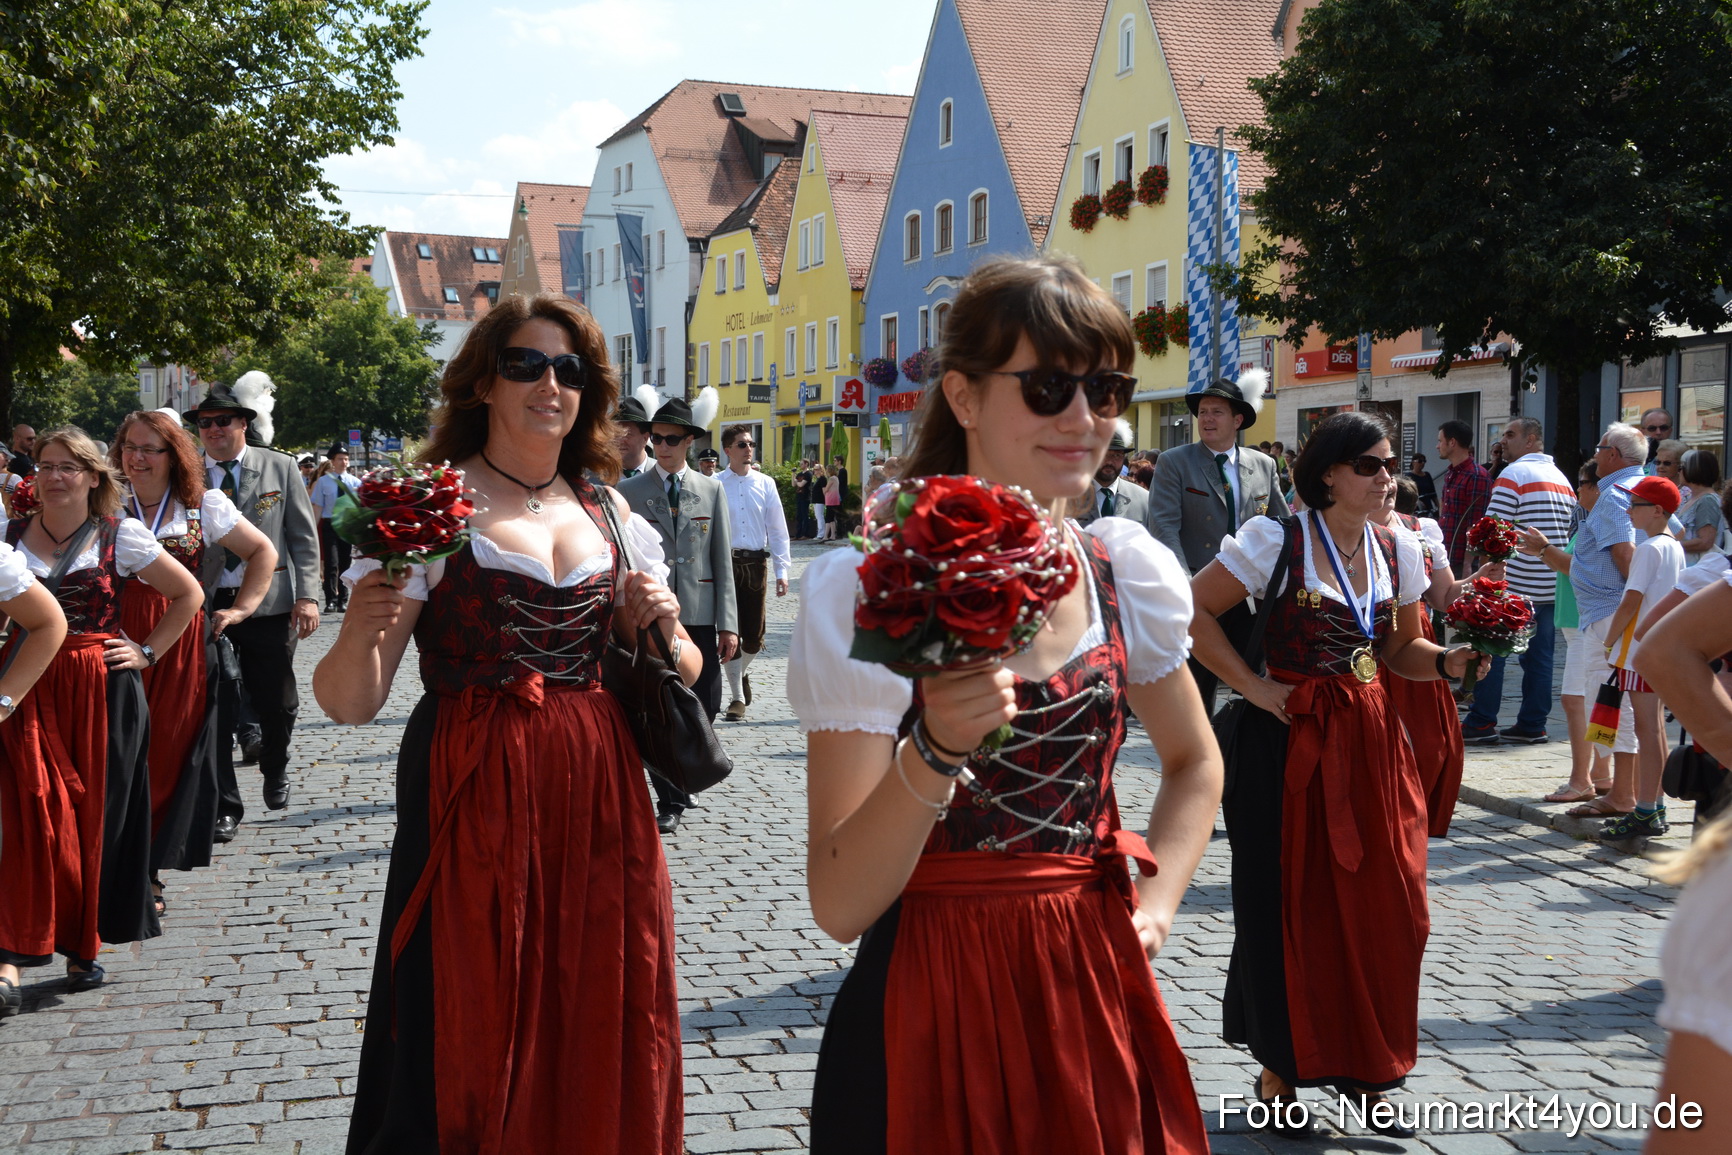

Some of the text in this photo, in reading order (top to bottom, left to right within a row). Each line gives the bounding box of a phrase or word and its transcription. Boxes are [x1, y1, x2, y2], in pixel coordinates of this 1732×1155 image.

[725, 309, 773, 332] HOTEL Lehmeier
[1331, 353, 1353, 363] DER
[723, 404, 751, 418] Restaurant
